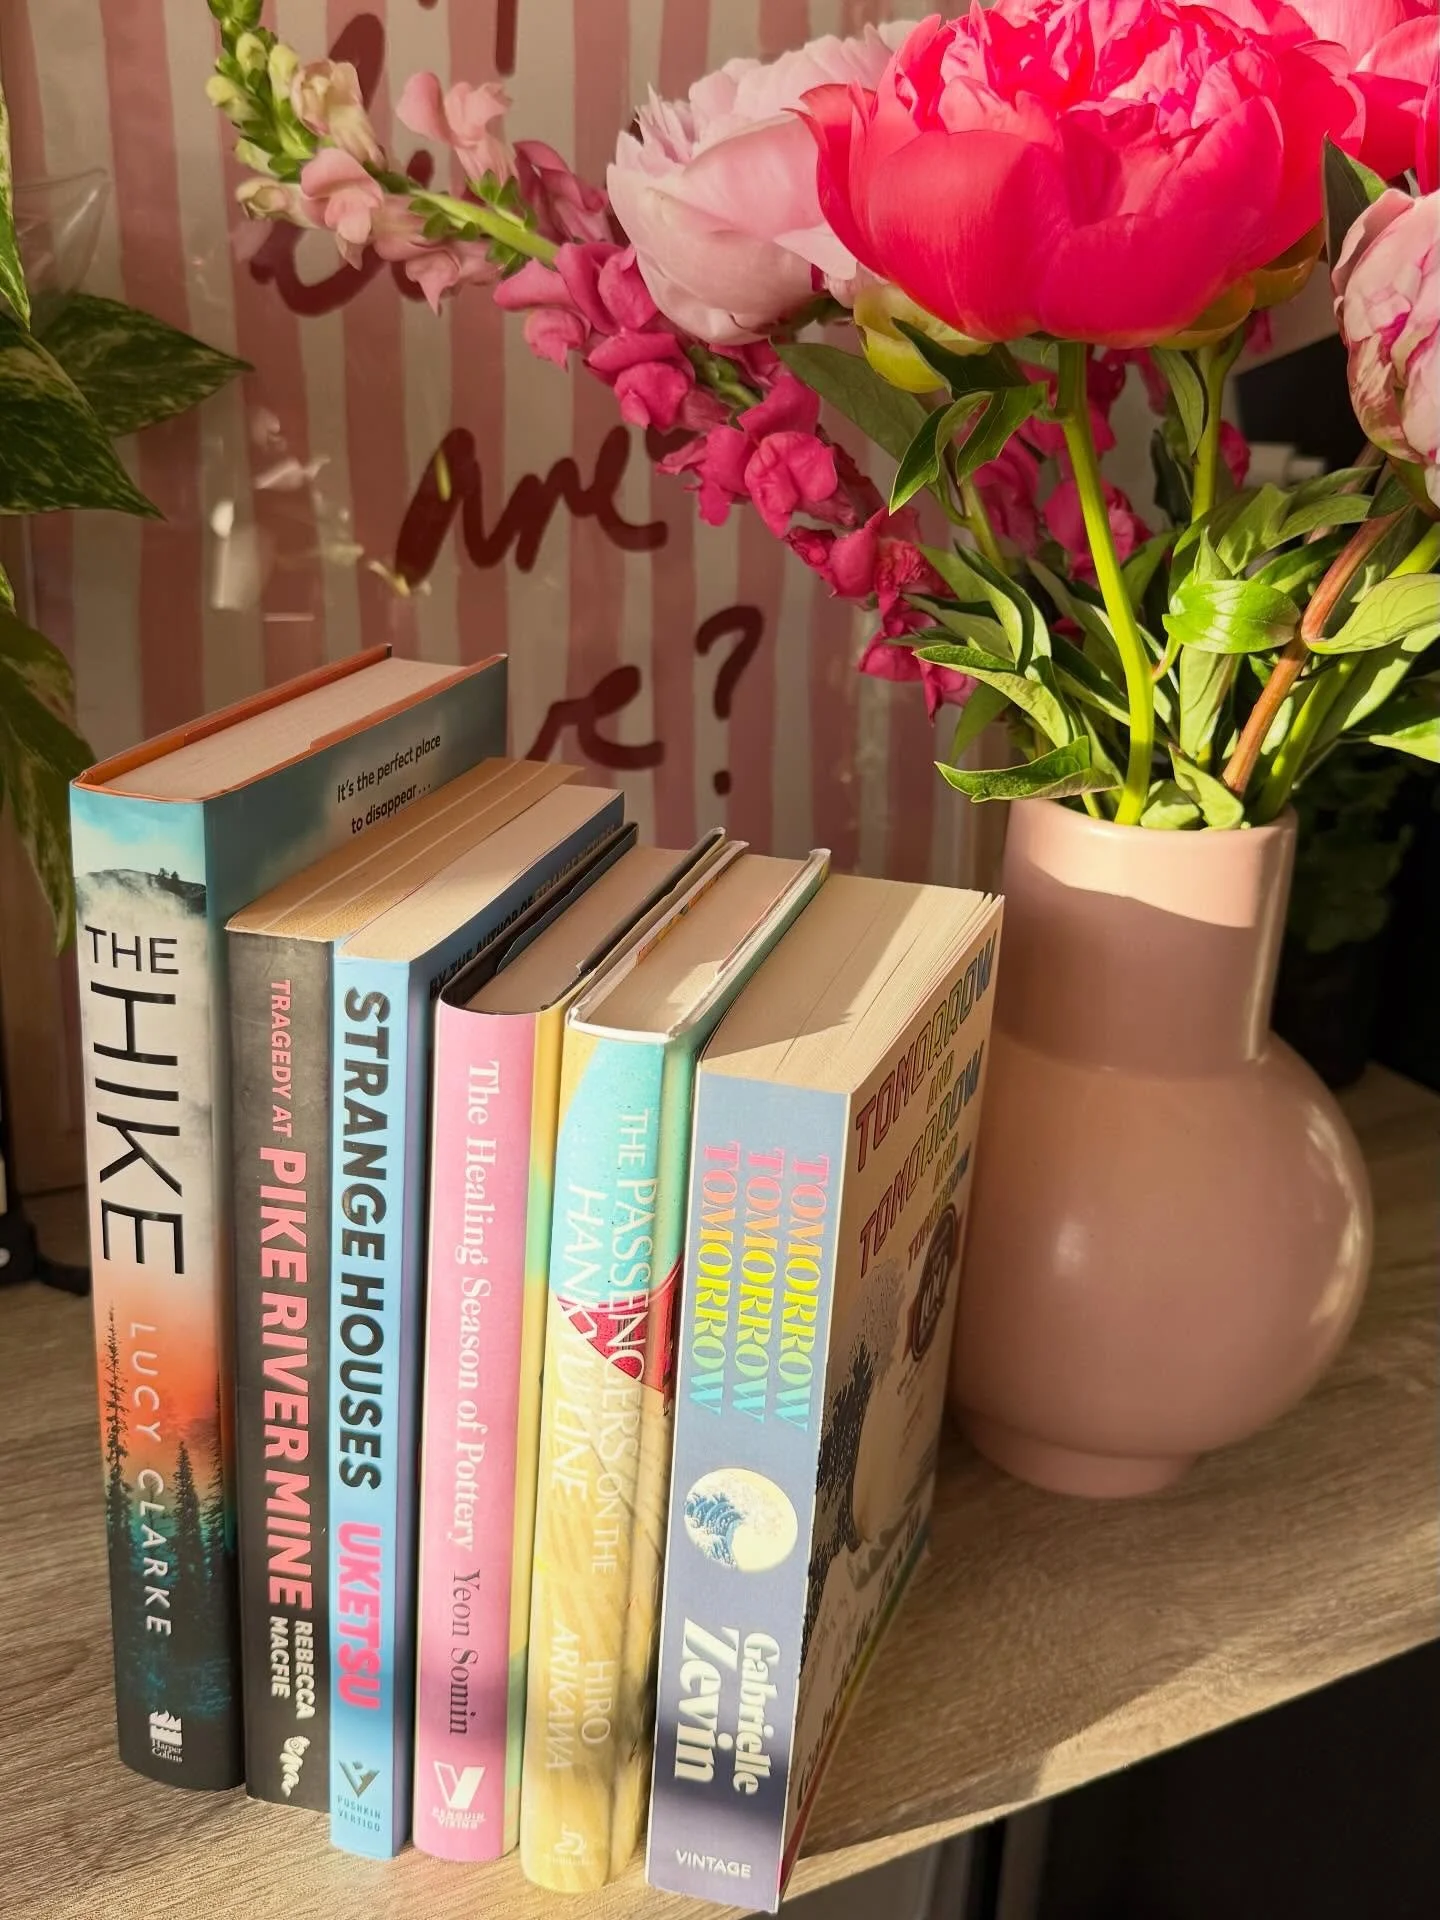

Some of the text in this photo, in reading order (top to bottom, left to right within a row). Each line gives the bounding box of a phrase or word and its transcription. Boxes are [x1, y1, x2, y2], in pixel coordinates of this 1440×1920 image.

[337, 735, 441, 804] It's the perfect place
[351, 816, 363, 835] to
[84, 925, 184, 1275] THE HIKE
[856, 928, 997, 1174] TOMORROW
[926, 1050, 954, 1115] AND
[338, 985, 391, 1490] STRANGE HOUSES
[859, 1040, 985, 1280] TOMORROW
[259, 979, 312, 1611] TRAGEDY AT PIKE RIVER MINE
[447, 1060, 500, 1554] The Healing Season of Pottery
[592, 1108, 657, 1575] THE PASSENGERS ON THE
[689, 1141, 742, 1417] TOMORROW
[730, 1146, 785, 1424] TOMORROW
[776, 1154, 831, 1432] TOMORROW
[129, 1322, 171, 1637] LUCY CLARKE
[269, 1616, 291, 1699] MACFIE
[295, 1619, 318, 1720] REBECCA
[337, 1521, 383, 1713] UKETSU
[449, 1568, 482, 1735] Yeon Somin
[545, 1620, 581, 1772] ARIKAWA
[151, 1738, 183, 1756] Harper
[151, 1747, 183, 1764] Collins
[581, 1659, 614, 1746] HIRO
[674, 1618, 741, 1783] Zevin
[732, 1630, 781, 1796] Gabrielle
[337, 1795, 382, 1819] PUSHKIN
[338, 1808, 381, 1833] VERTIGO
[675, 1847, 752, 1878] VINTAGE
